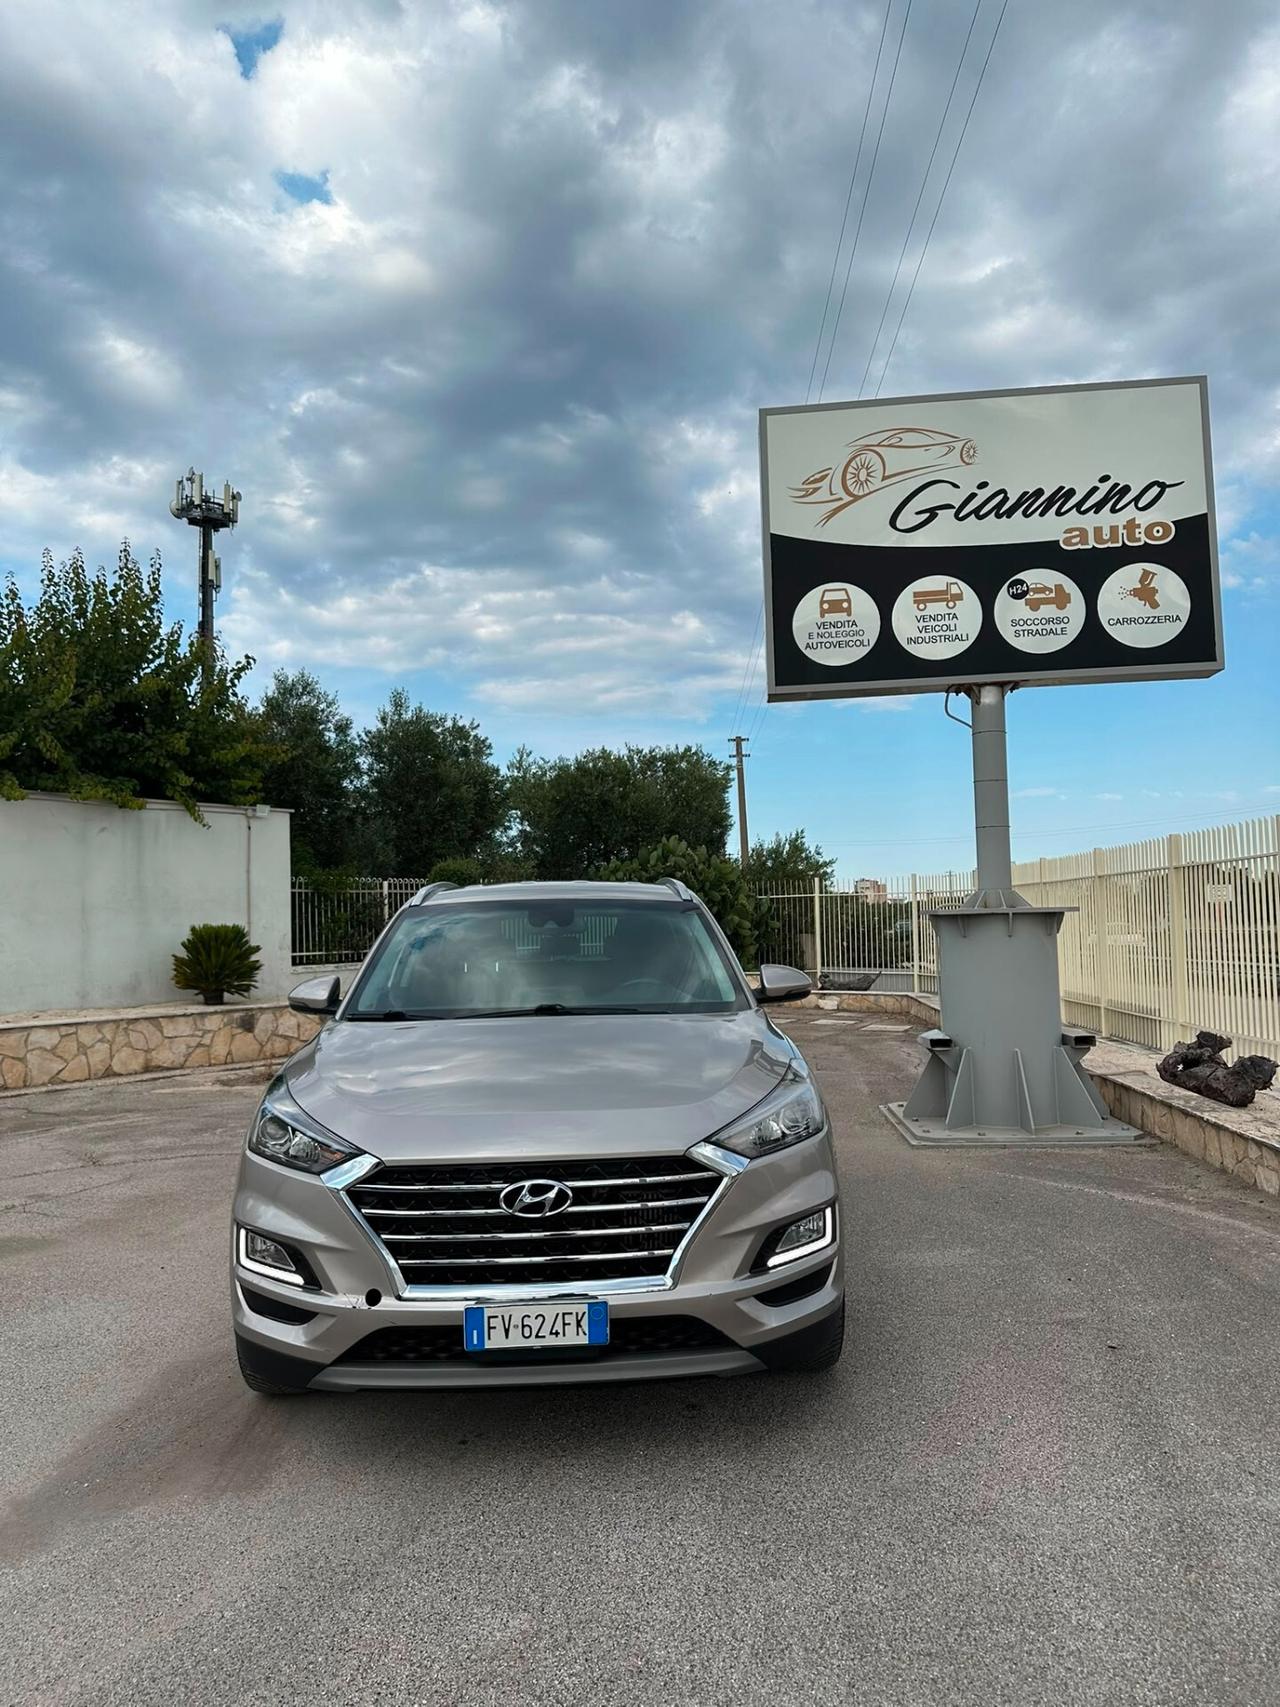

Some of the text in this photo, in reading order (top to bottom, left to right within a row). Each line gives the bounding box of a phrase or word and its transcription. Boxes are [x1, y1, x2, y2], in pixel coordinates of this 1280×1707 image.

[888, 474, 1185, 533] Giannino
[1060, 518, 1175, 549] auto
[1009, 583, 1028, 596] H24
[915, 613, 958, 623] VENDITA
[1010, 616, 1070, 627] SOCCORSO
[1108, 614, 1182, 626] CARROZZERIA
[816, 620, 858, 630] VENDITA
[917, 624, 957, 633] VEICOLI
[808, 629, 865, 640] E NOLEGGIO
[1014, 627, 1068, 638] STRADALE
[804, 639, 870, 650] AUTOVEICOLI
[906, 633, 969, 645] INDUSTRIALI
